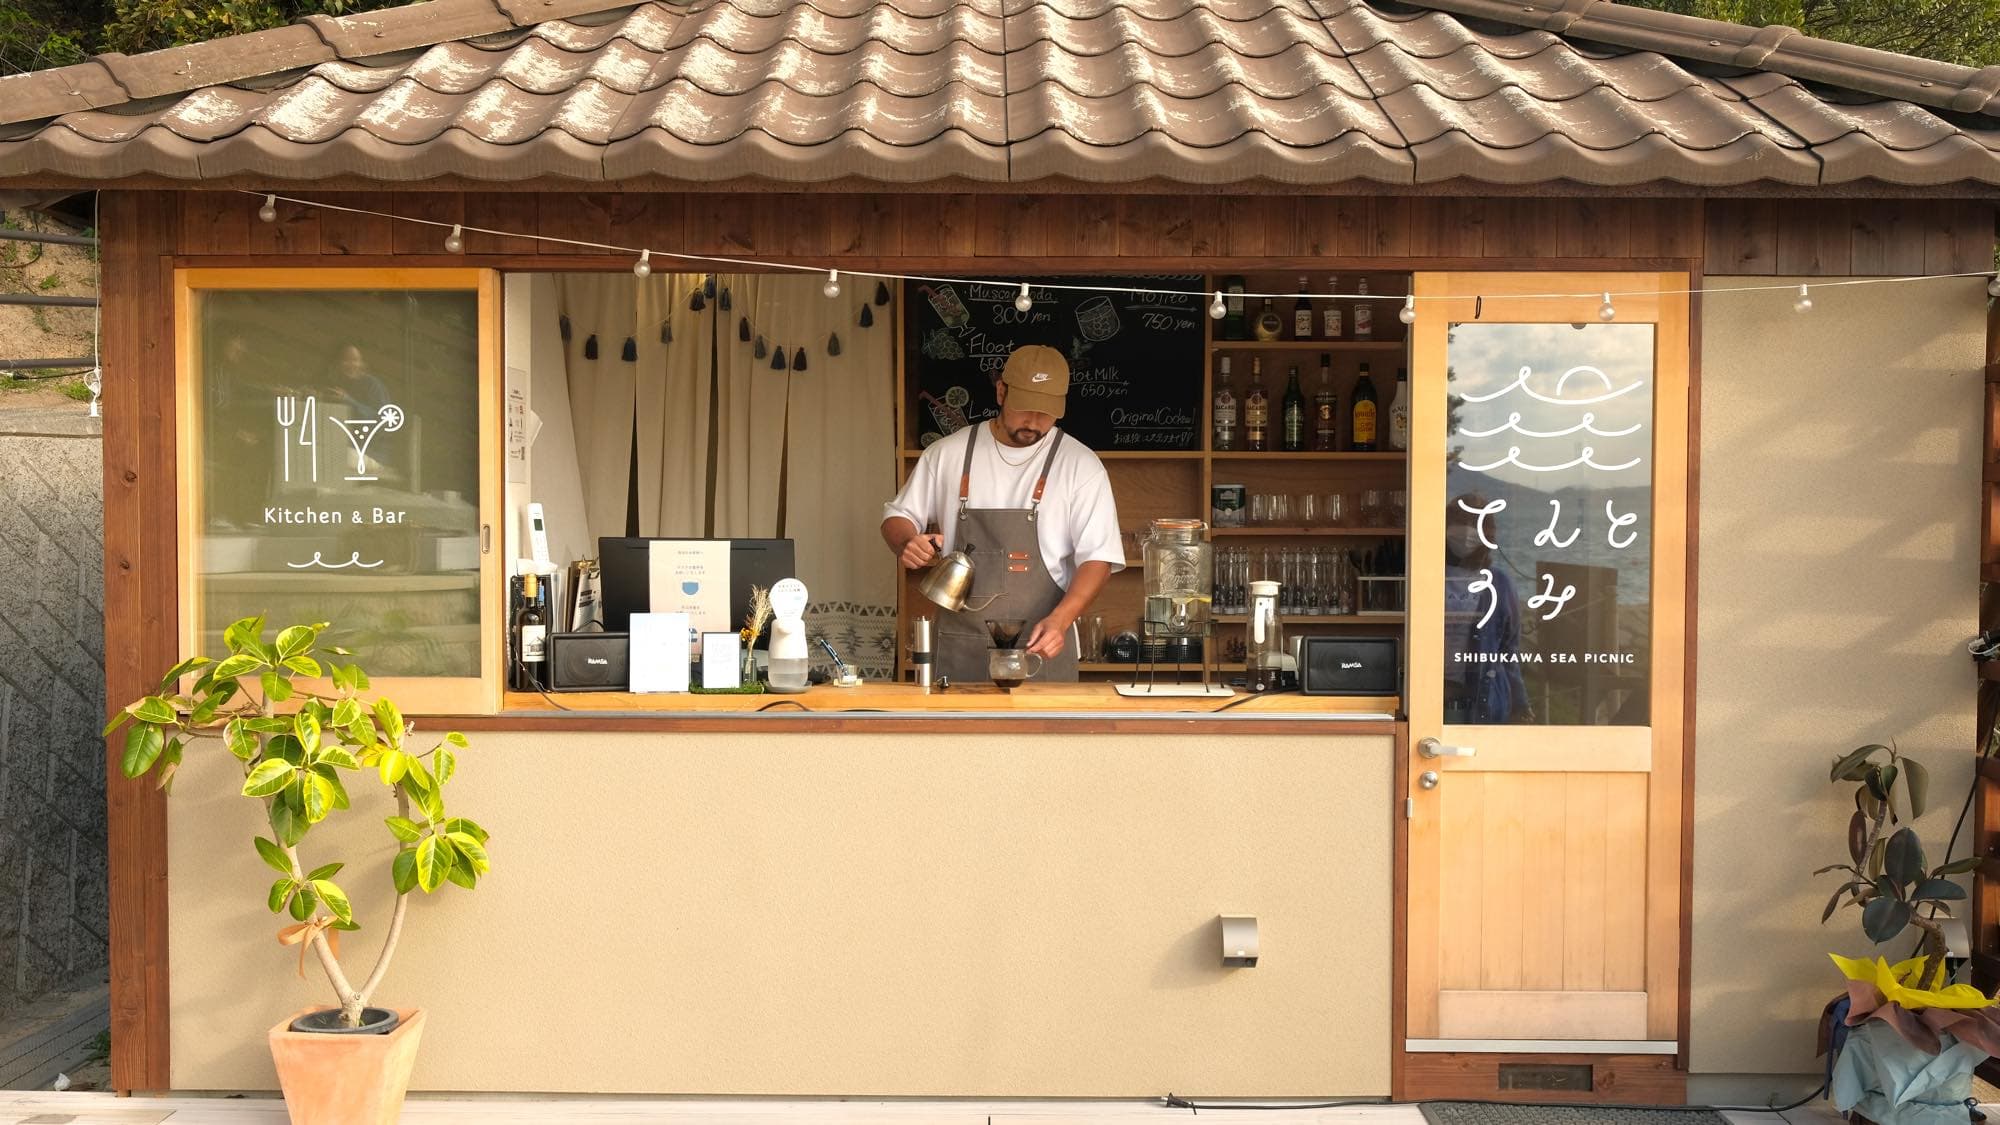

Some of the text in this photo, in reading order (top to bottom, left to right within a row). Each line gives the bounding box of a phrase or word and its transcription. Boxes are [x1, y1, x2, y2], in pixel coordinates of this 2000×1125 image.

[992, 304, 1051, 325] 800 yen
[1142, 313, 1196, 331] 750 yen
[970, 333, 1015, 353] Float
[980, 357, 1003, 372] 650
[1081, 384, 1128, 398] 650 yen
[264, 507, 406, 524] Kitchen & Bar
[1454, 652, 1635, 663] SHIBUKAWA SEA PICNIC
